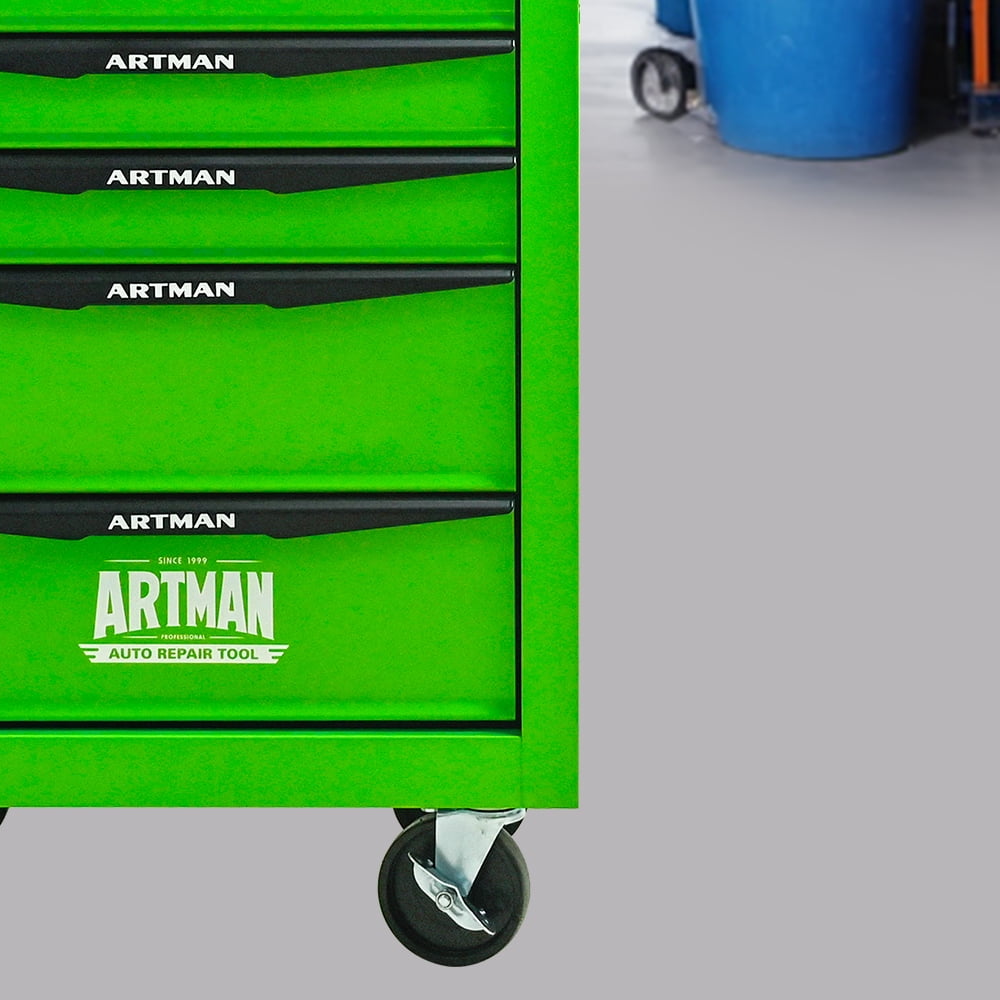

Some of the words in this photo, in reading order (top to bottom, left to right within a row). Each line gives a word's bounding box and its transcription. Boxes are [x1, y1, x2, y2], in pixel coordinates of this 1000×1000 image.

[105, 54, 234, 70] ARTMAN
[106, 169, 235, 186] ARTMAN
[106, 281, 235, 299] ARTMAN
[107, 512, 236, 531] ARTMAN
[158, 556, 182, 565] SINCE
[187, 556, 208, 565] 1999
[93, 570, 275, 640] ARTMAN
[109, 648, 152, 660] AUTO
[157, 648, 213, 660] REPAIR
[217, 648, 259, 660] TOOL
